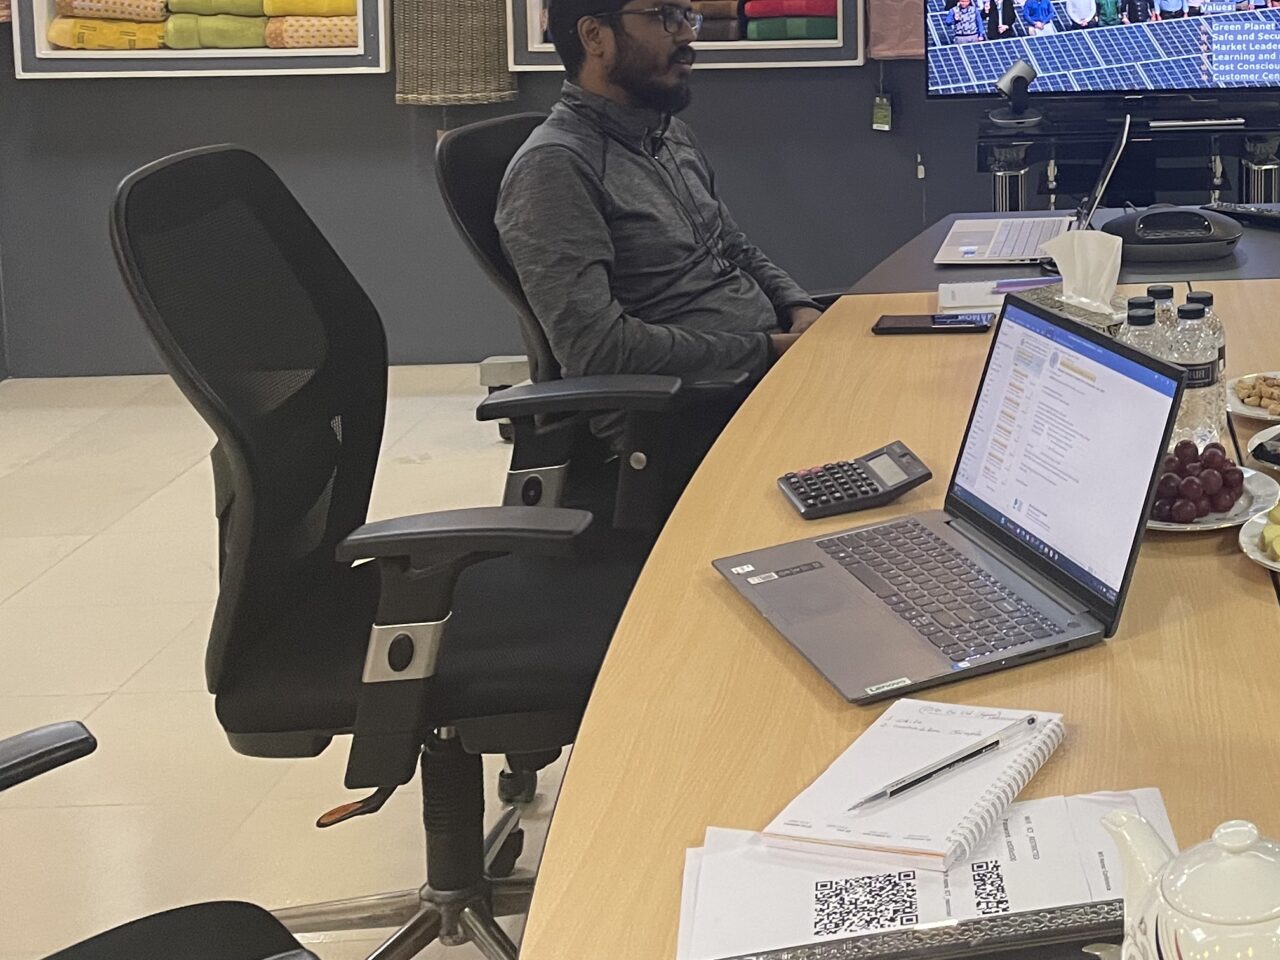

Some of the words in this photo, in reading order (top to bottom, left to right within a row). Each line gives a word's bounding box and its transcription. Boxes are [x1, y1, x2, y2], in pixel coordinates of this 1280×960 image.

[1200, 3, 1235, 11] Values:
[1212, 23, 1241, 31] Green
[1244, 22, 1275, 30] Planet
[1212, 33, 1234, 41] Safe
[1212, 43, 1246, 51] Market
[1212, 53, 1255, 62] Learning
[1258, 52, 1276, 60] and
[1212, 63, 1234, 71] Cost
[1212, 73, 1259, 81] Customer
[869, 679, 906, 693] Lenovo
